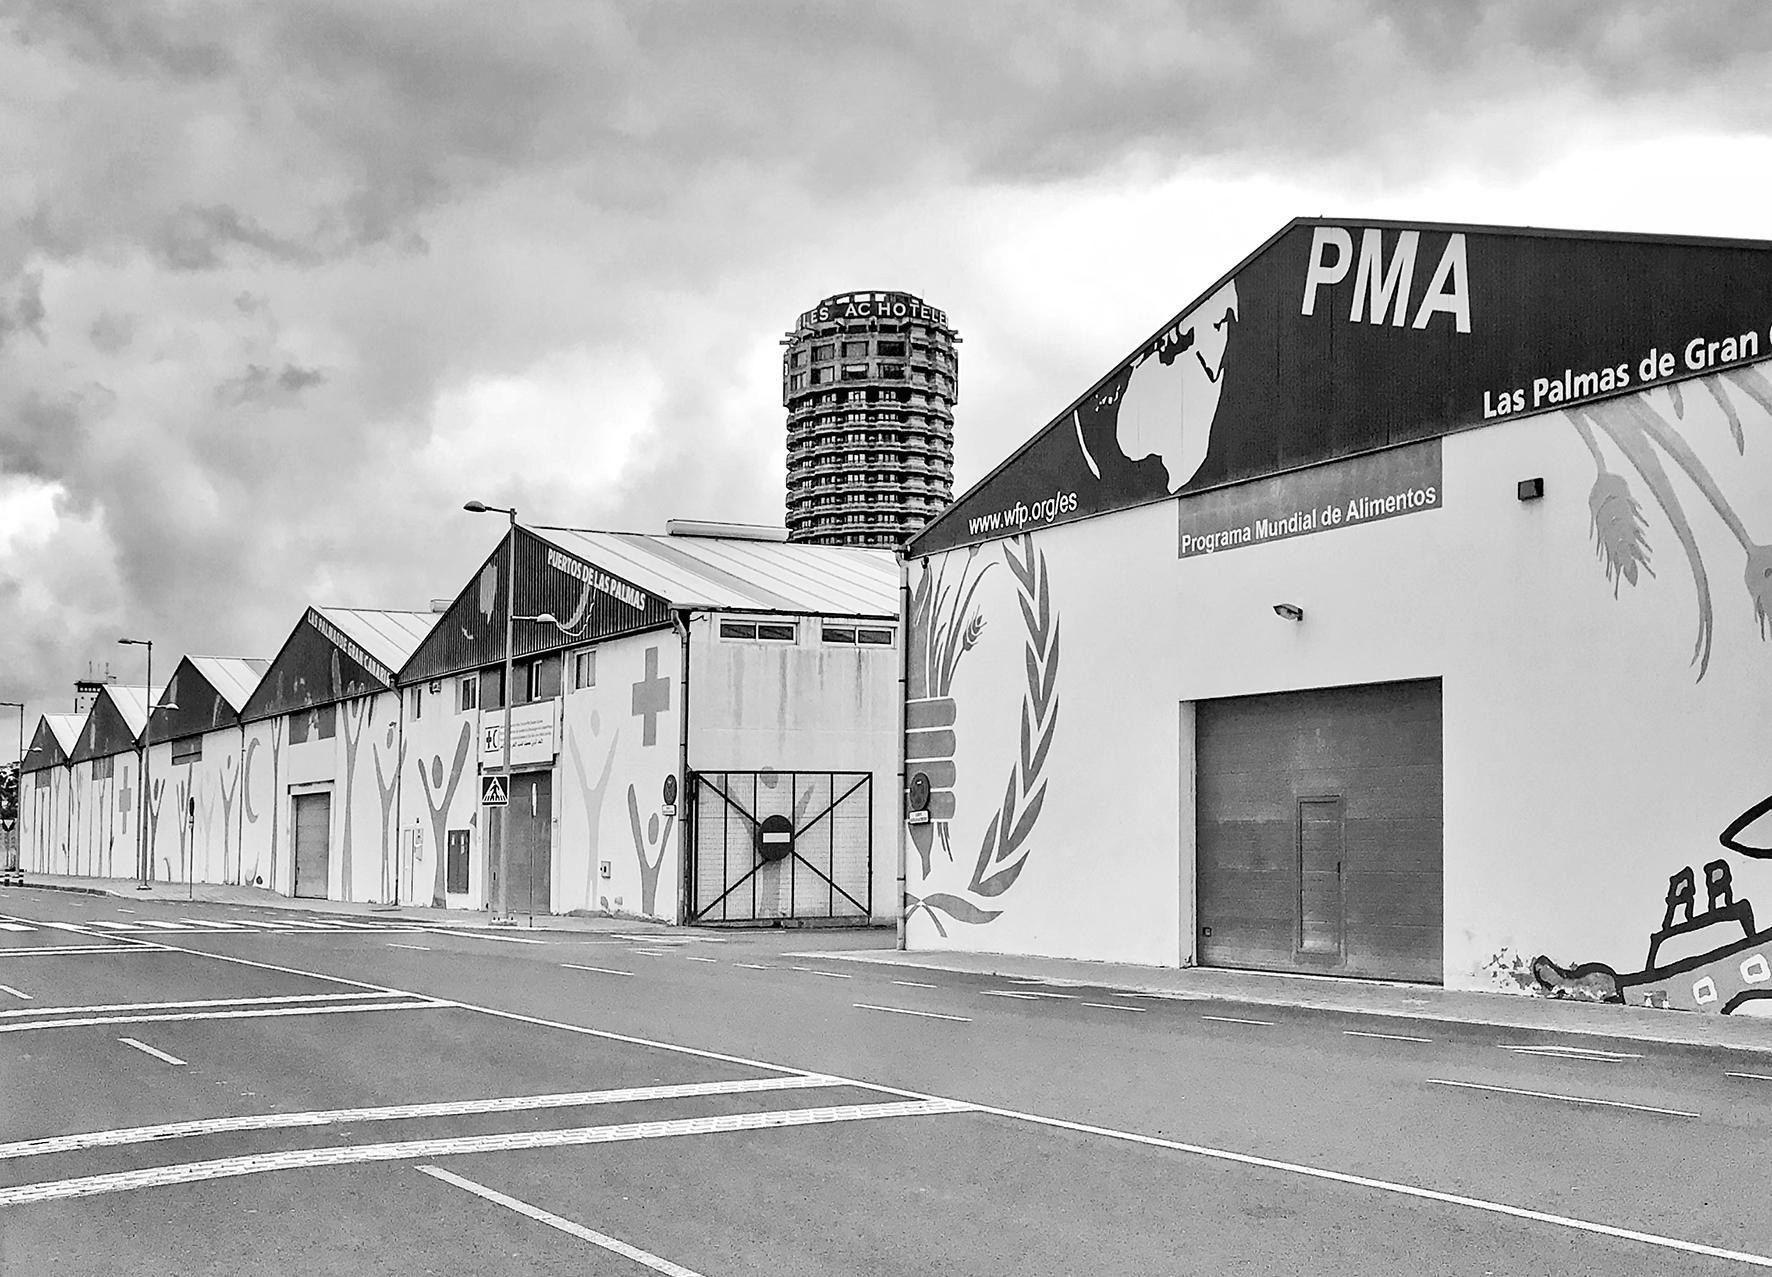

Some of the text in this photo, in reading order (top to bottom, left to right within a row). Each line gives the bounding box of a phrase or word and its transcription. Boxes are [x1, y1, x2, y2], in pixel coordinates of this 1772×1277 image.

[845, 303, 871, 317] AC
[1301, 226, 1472, 334] PMA
[1483, 388, 1526, 419] Las
[1533, 363, 1630, 407] Palmas
[1638, 348, 1676, 382] de
[1684, 330, 1759, 370] Gran
[968, 491, 1078, 535] www.wfp.org/es
[1182, 486, 1437, 554] Programa Mundial de Alimentos
[548, 548, 646, 611] PUERTOS DE LAS PALMAS
